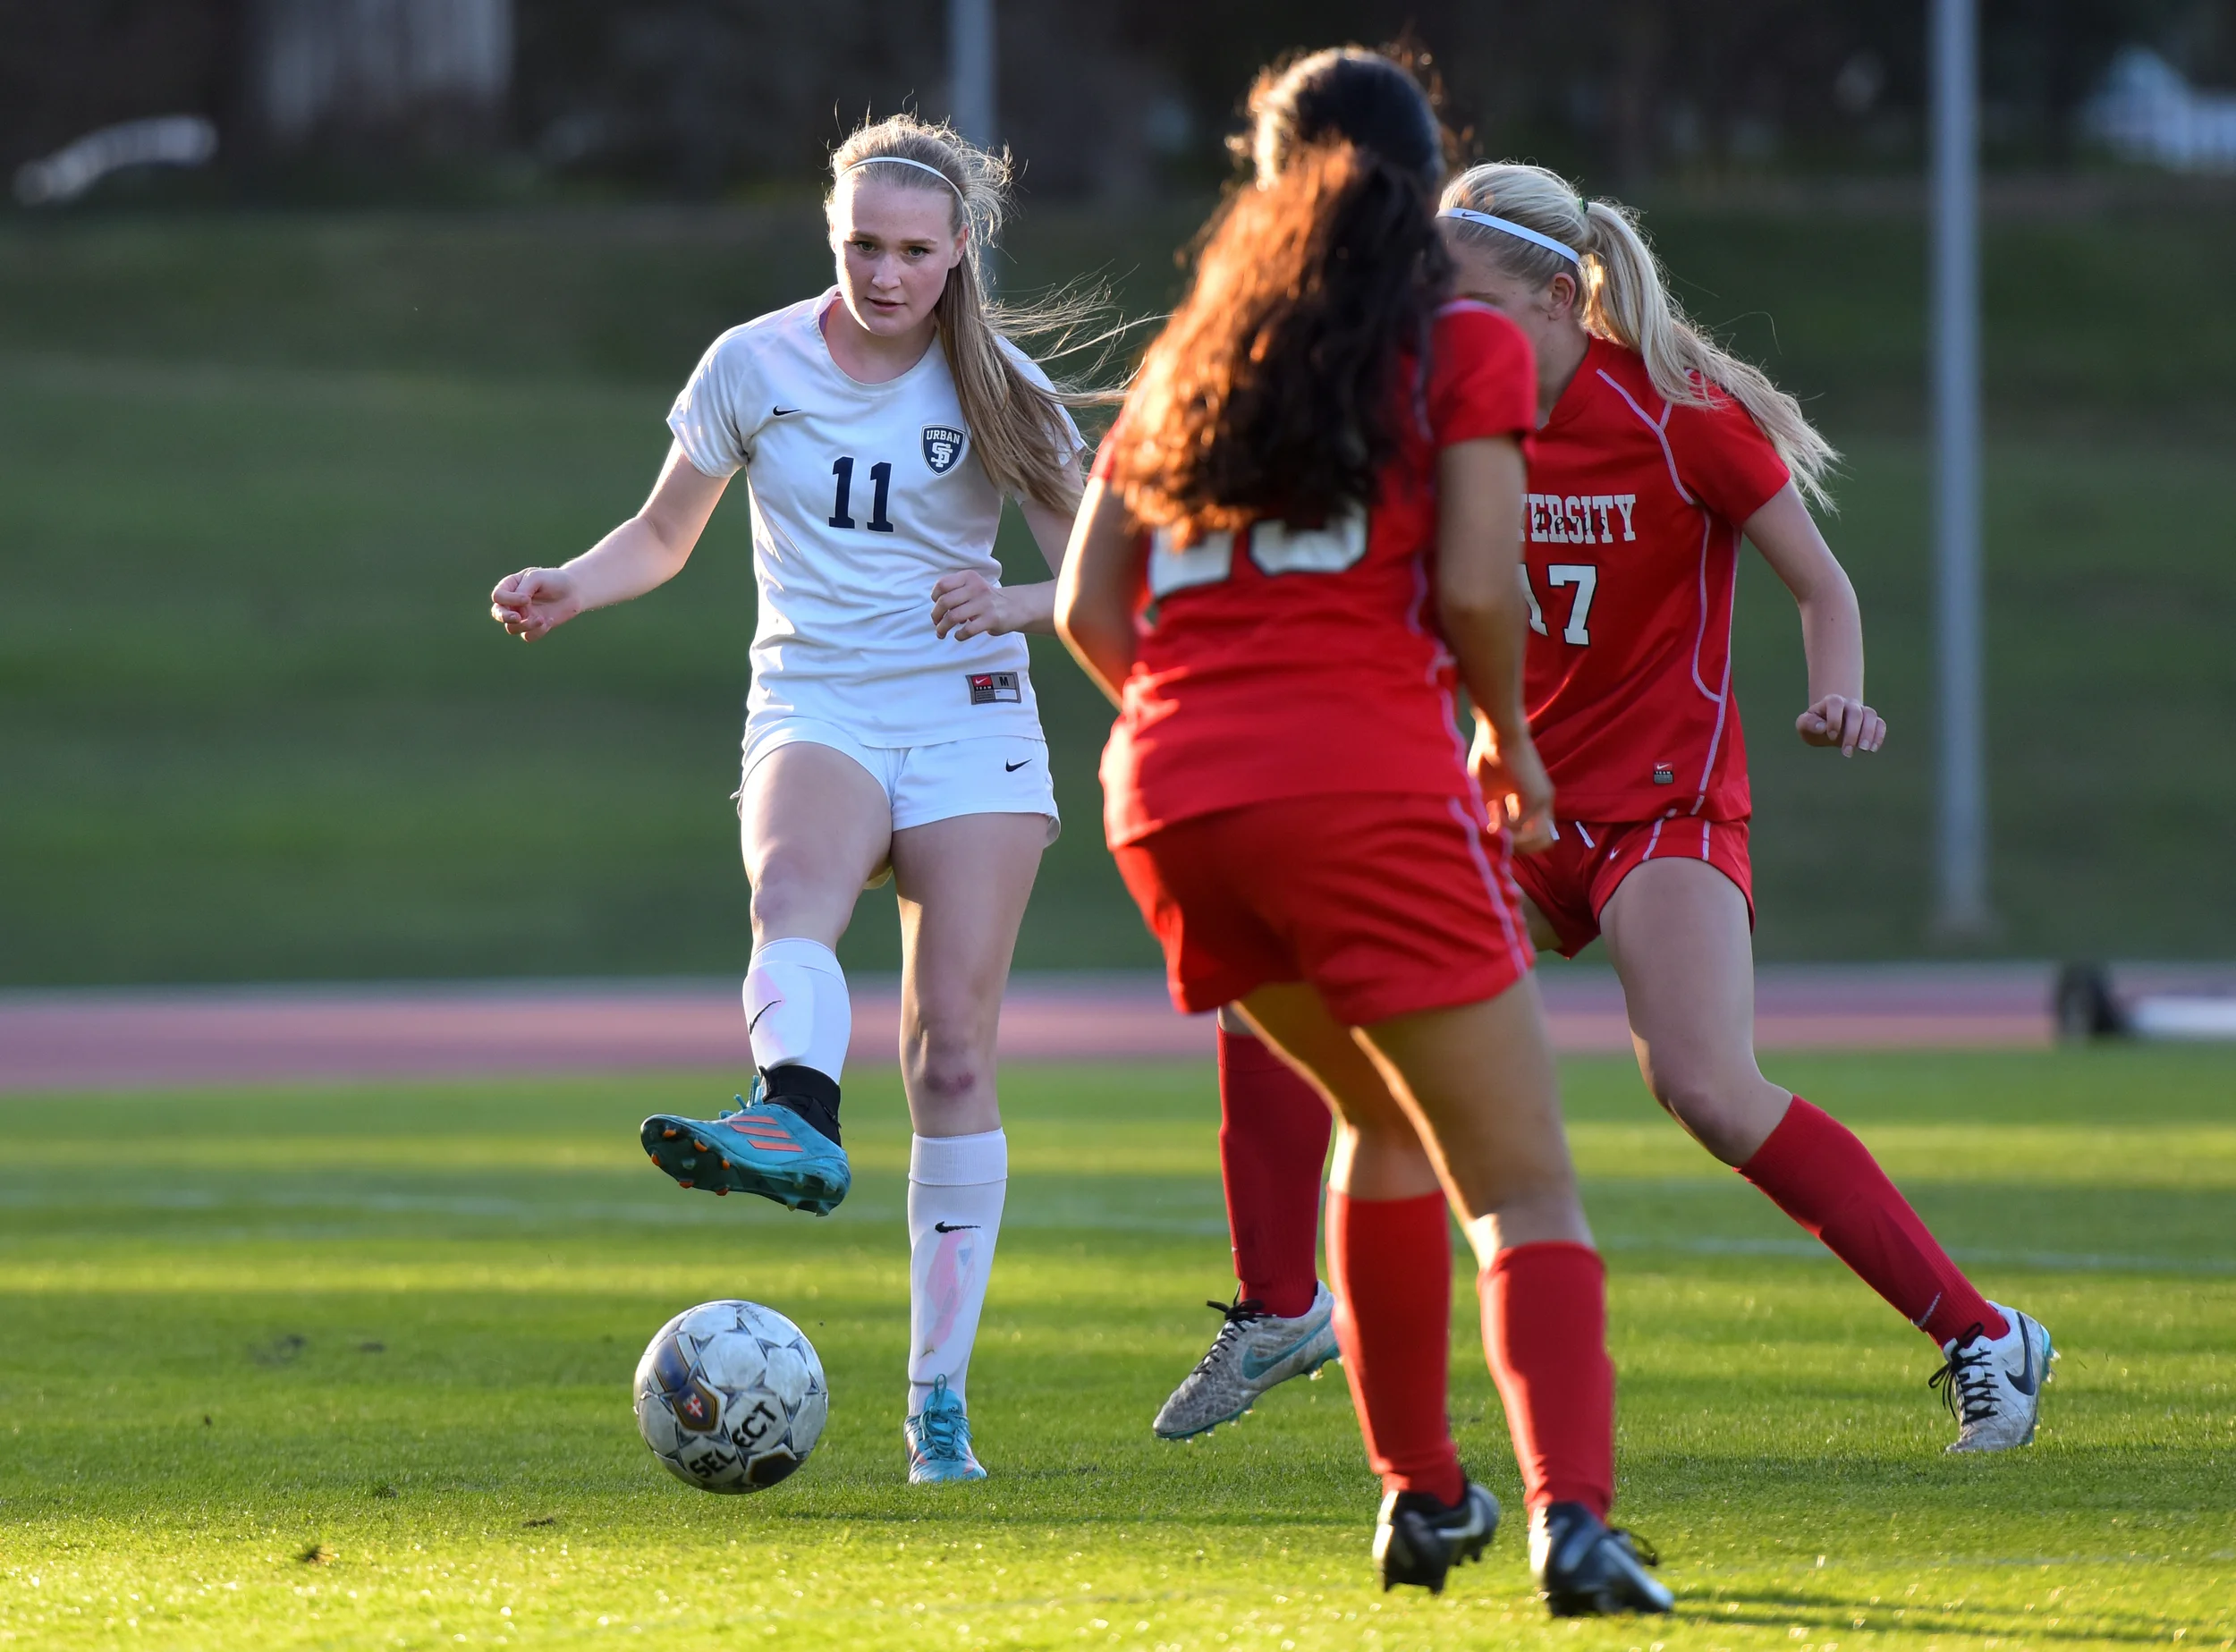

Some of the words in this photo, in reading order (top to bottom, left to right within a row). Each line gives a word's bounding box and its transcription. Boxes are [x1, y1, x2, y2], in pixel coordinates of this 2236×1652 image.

[926, 429, 961, 445] URBAN
[827, 455, 894, 533] 11
[1533, 507, 1606, 533] Devils
[998, 676, 1010, 687] M
[689, 1401, 777, 1478] SELECT
